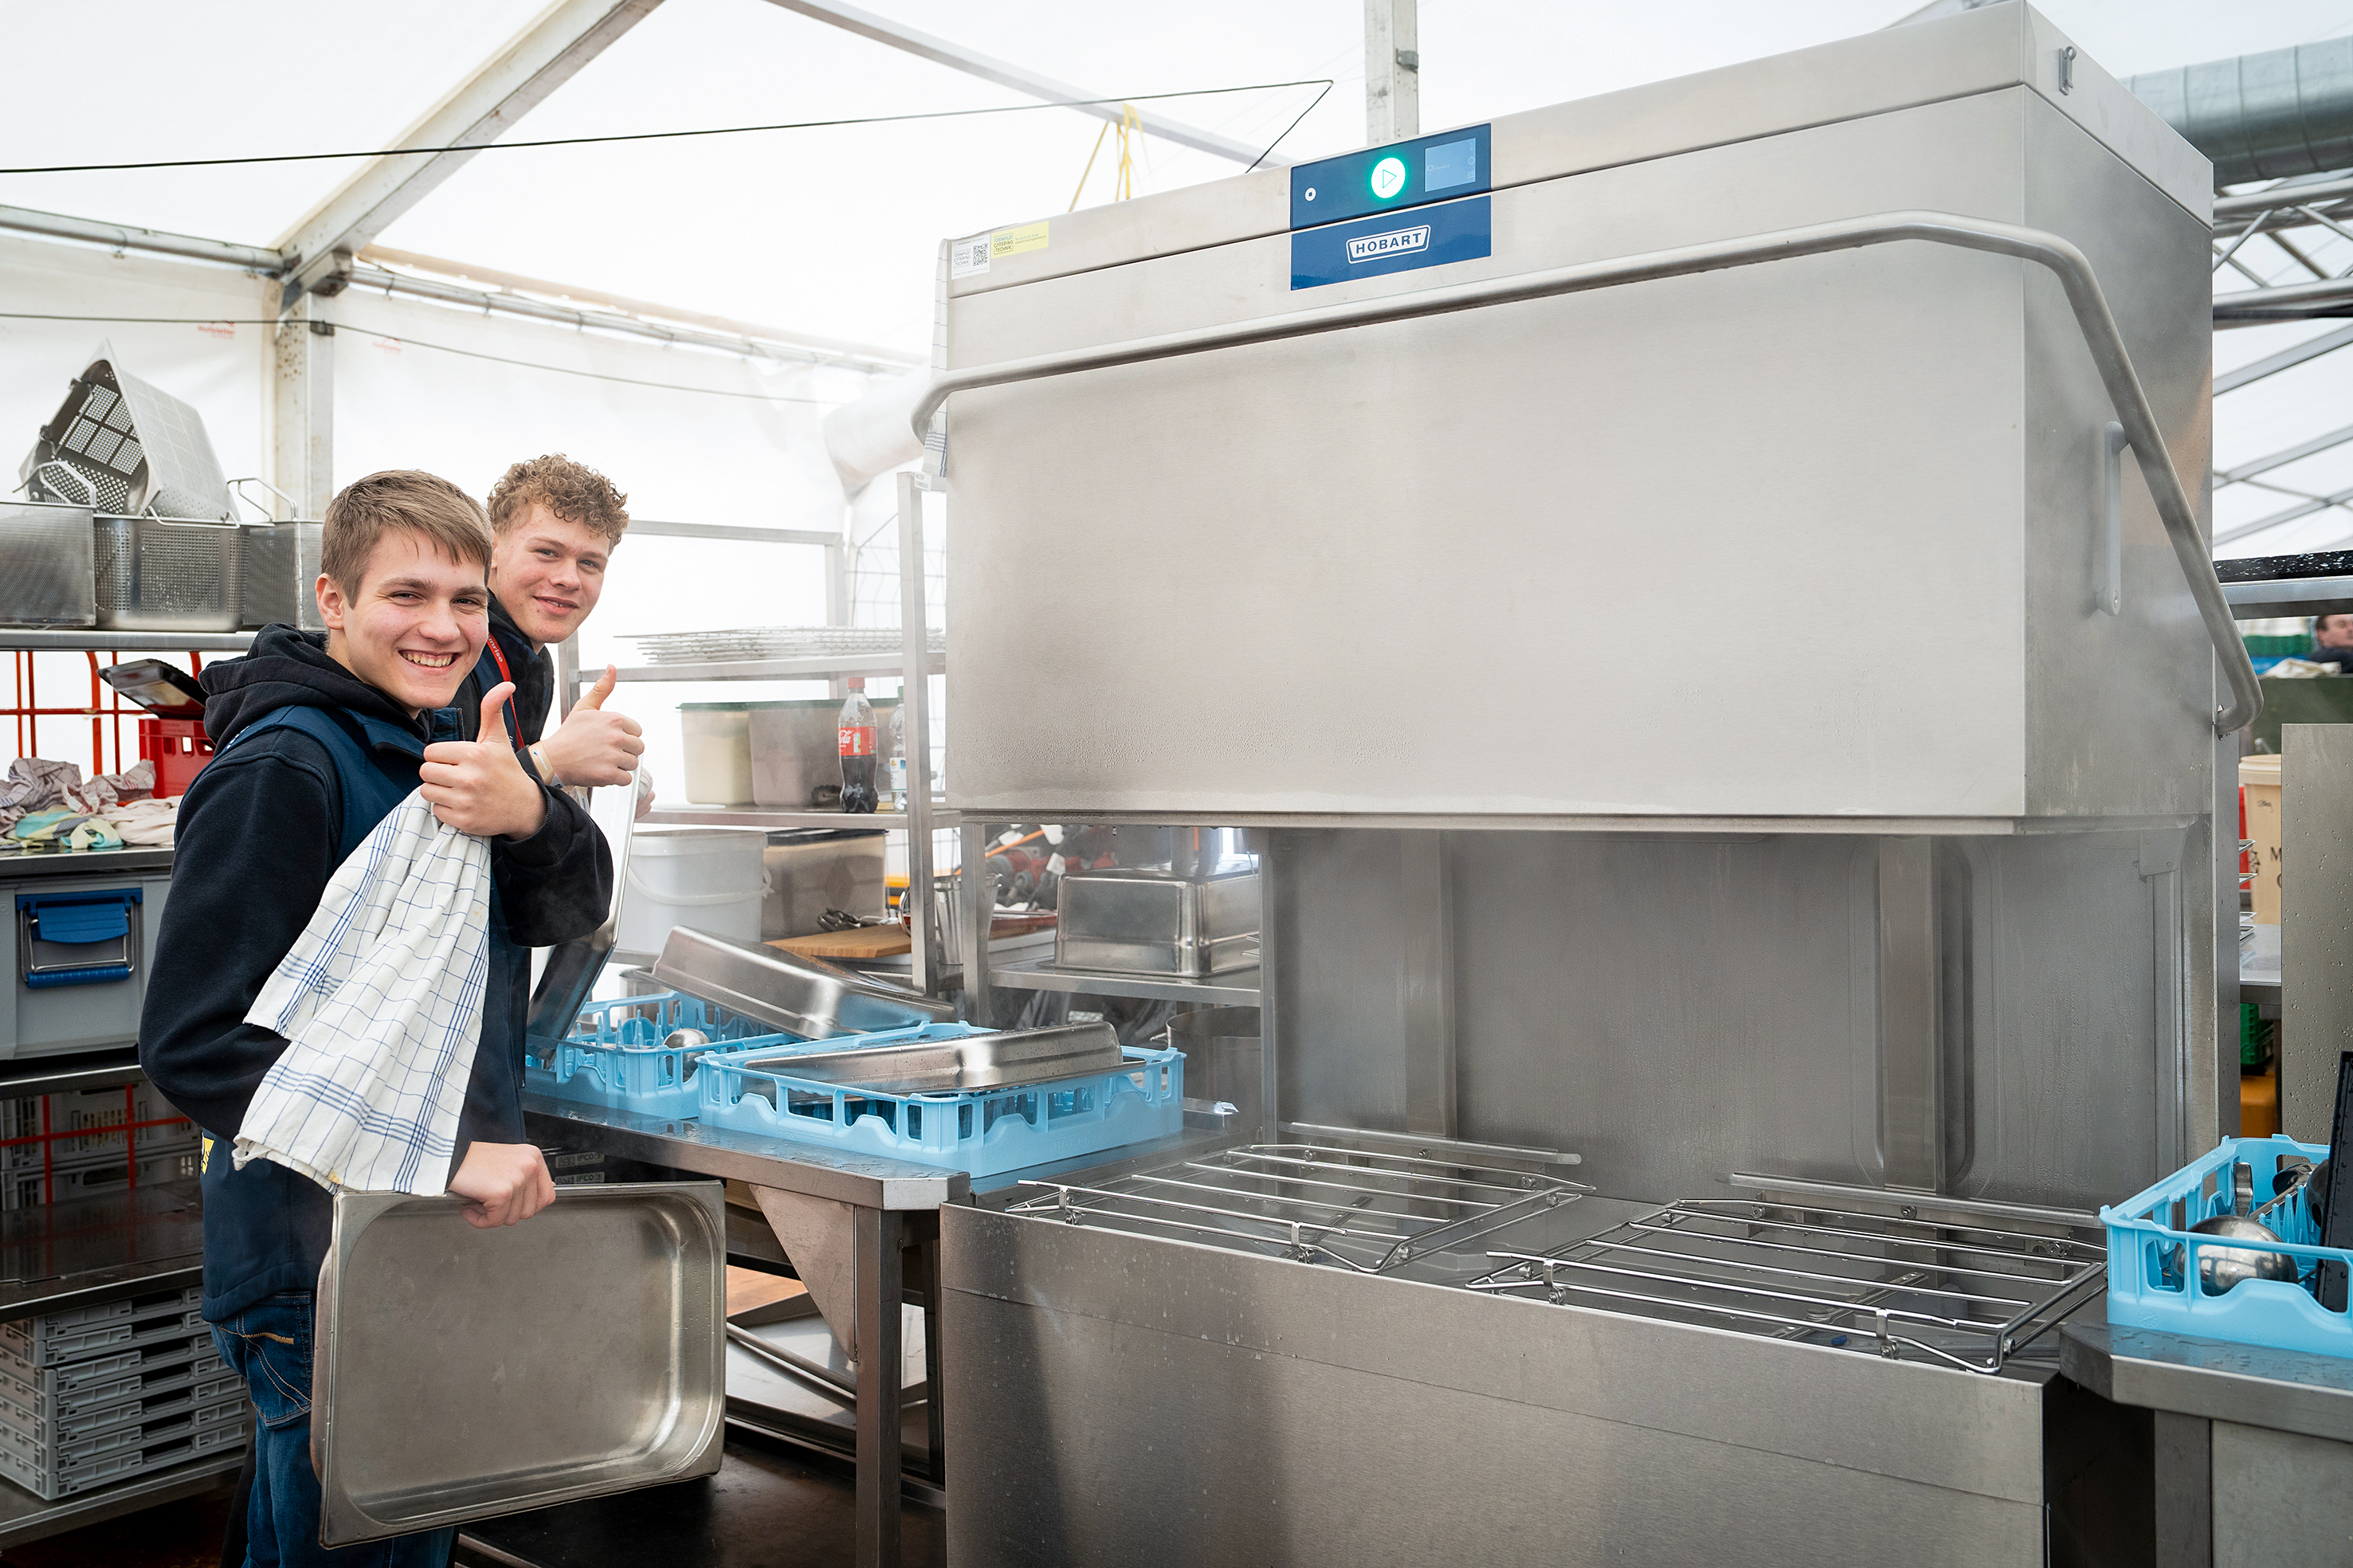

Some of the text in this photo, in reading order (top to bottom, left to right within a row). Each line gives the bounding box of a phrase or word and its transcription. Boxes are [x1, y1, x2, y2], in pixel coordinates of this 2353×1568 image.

[994, 239, 1014, 248] CATERING
[1356, 233, 1422, 254] HOBART
[488, 632, 503, 662] unrise
[577, 1153, 594, 1162] IFCO
[576, 1174, 594, 1182] IFCO
